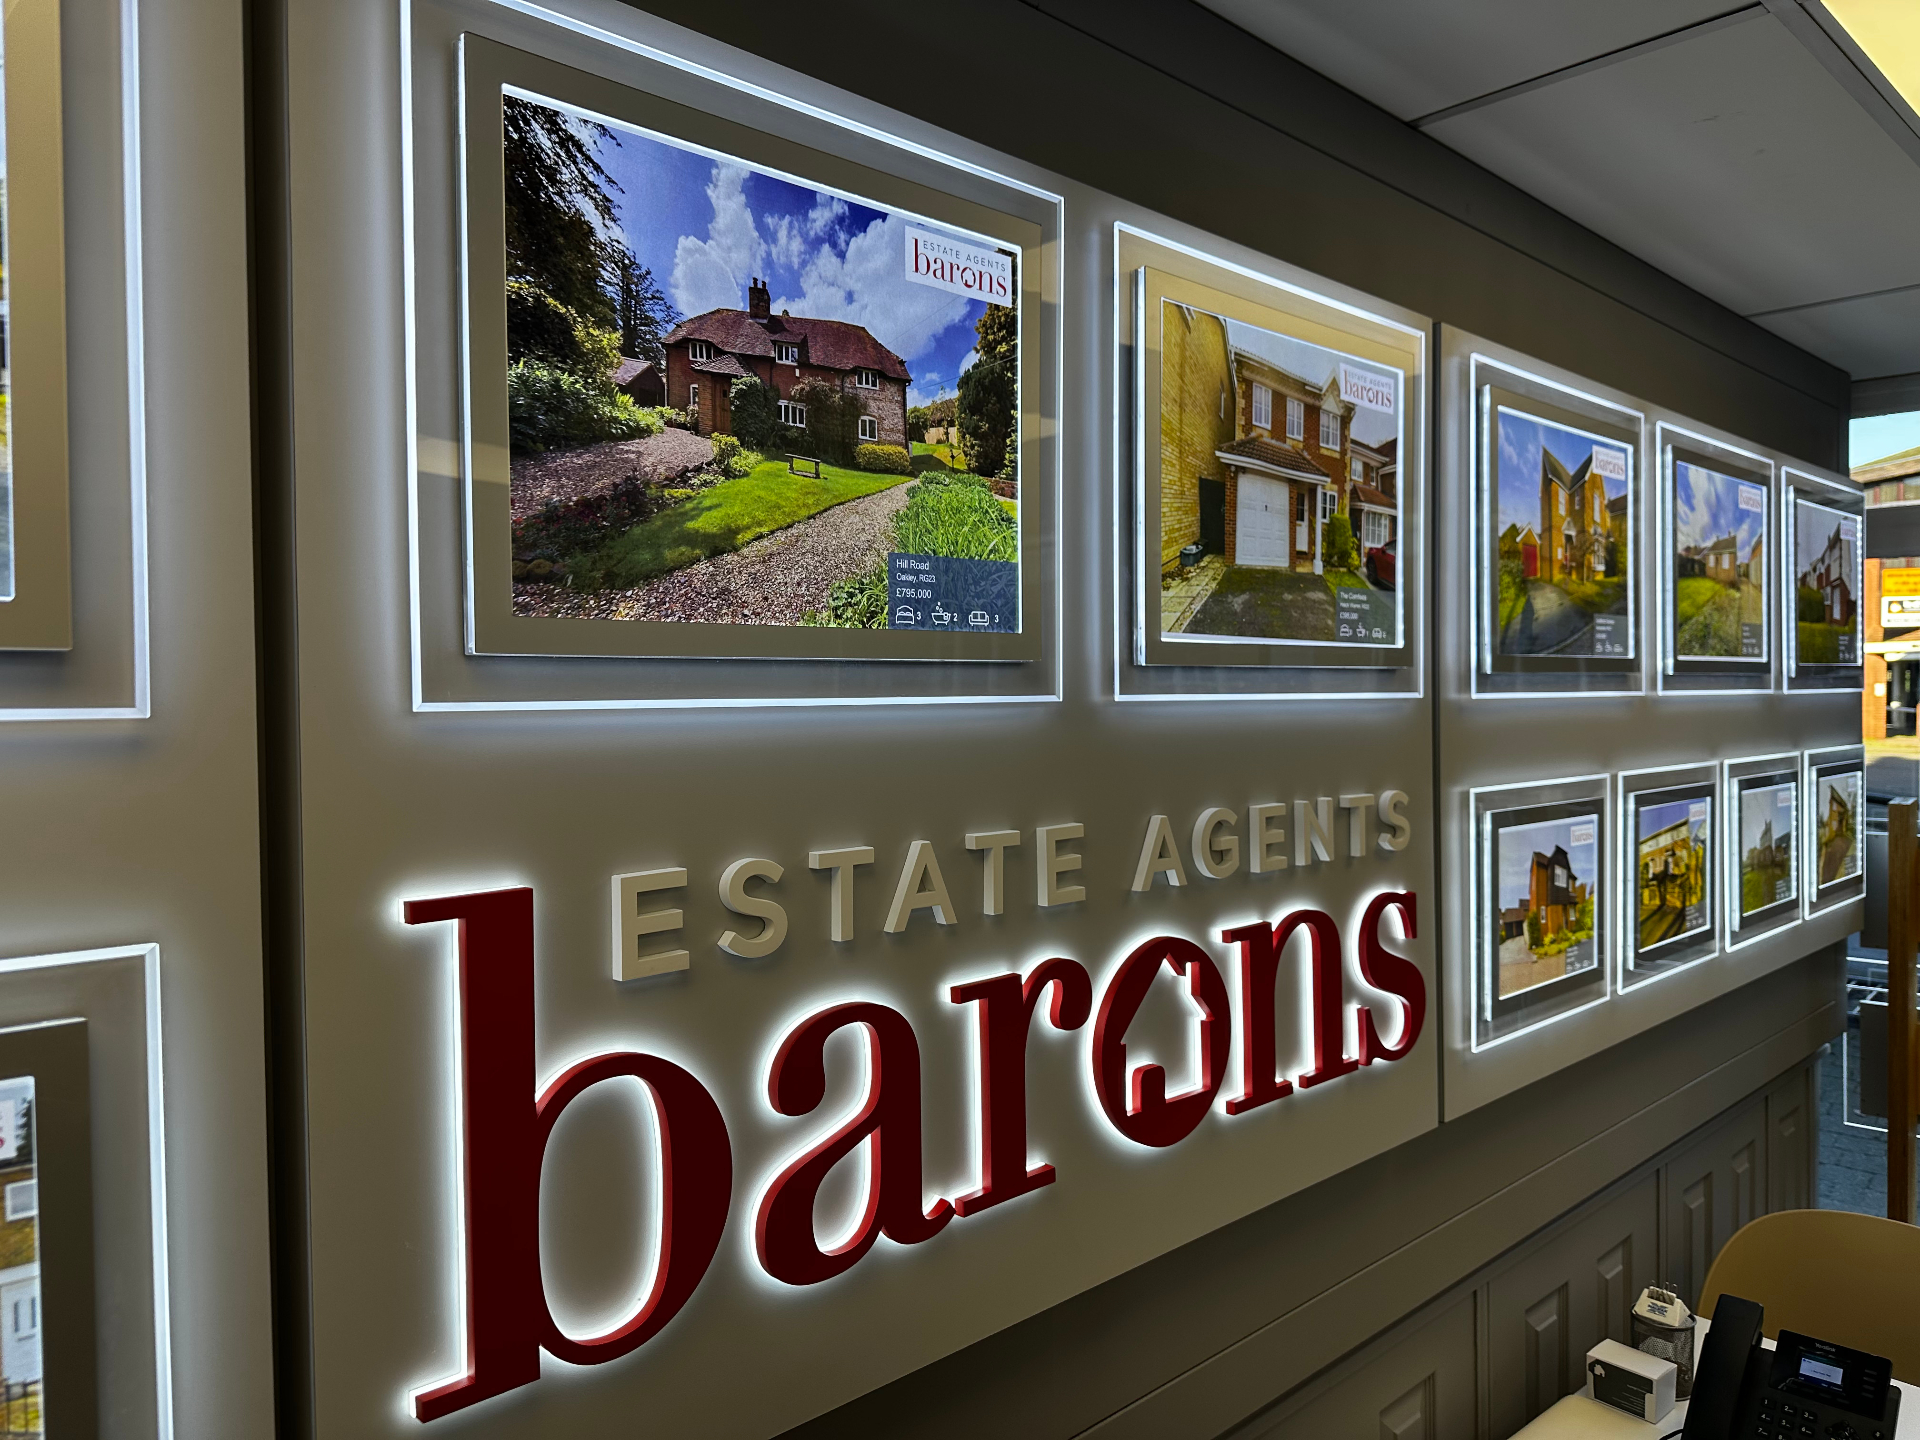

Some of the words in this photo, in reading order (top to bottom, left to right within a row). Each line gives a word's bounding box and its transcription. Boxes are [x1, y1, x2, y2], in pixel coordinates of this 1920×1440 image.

[911, 237, 1008, 298] barons
[922, 240, 961, 260] ESTATE
[965, 255, 1007, 272] AGENTS
[1343, 370, 1392, 407] barons
[896, 559, 909, 569] Hill
[909, 559, 930, 570] Road
[896, 572, 918, 584] Oakley,
[919, 573, 936, 583] RG23
[895, 587, 932, 599] £795,000
[916, 611, 922, 621] 3
[953, 612, 958, 622] 2
[994, 614, 999, 623] 3
[611, 821, 1088, 983] ESTATE
[1130, 789, 1412, 893] AGENTS
[402, 885, 1427, 1424] barons
